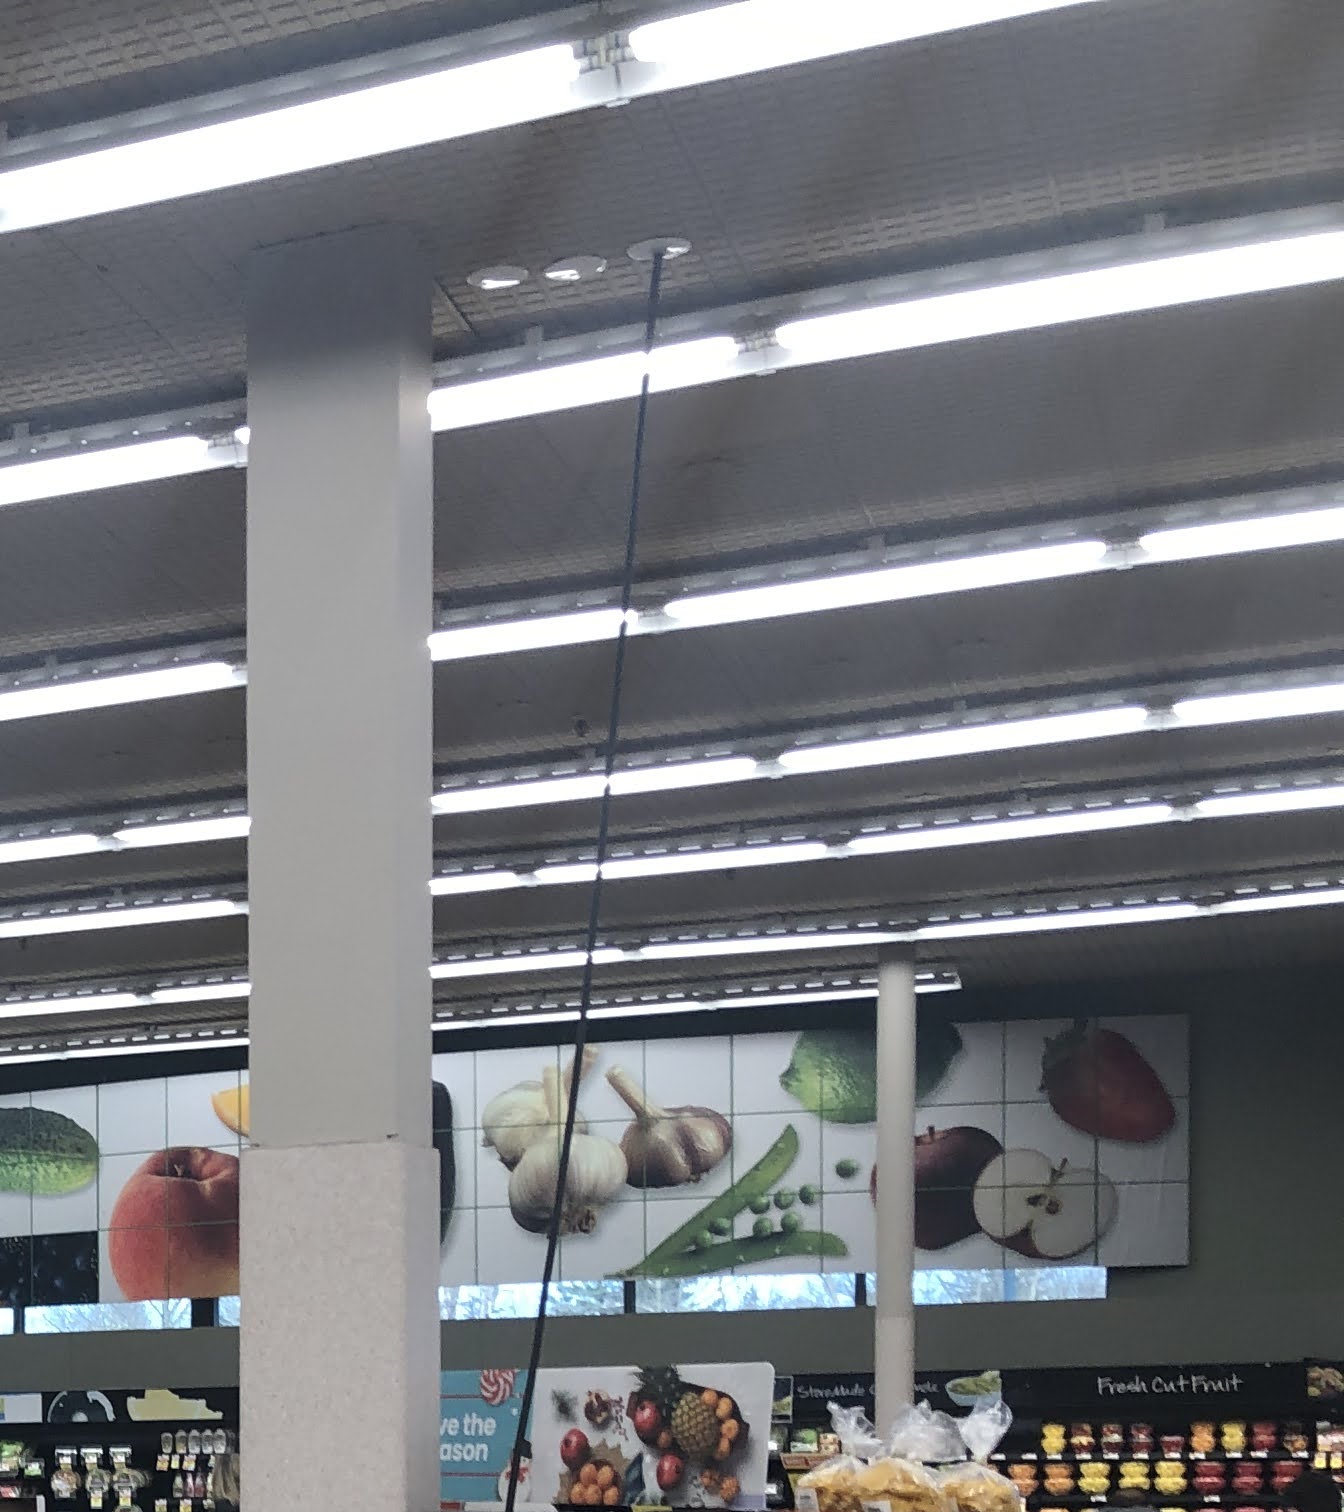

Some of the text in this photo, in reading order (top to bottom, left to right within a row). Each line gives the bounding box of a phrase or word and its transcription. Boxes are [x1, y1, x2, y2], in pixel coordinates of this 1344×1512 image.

[1097, 1374, 1244, 1396] Fresh Cut Fruit
[440, 1412, 496, 1436] ve the
[440, 1440, 489, 1462] ason
